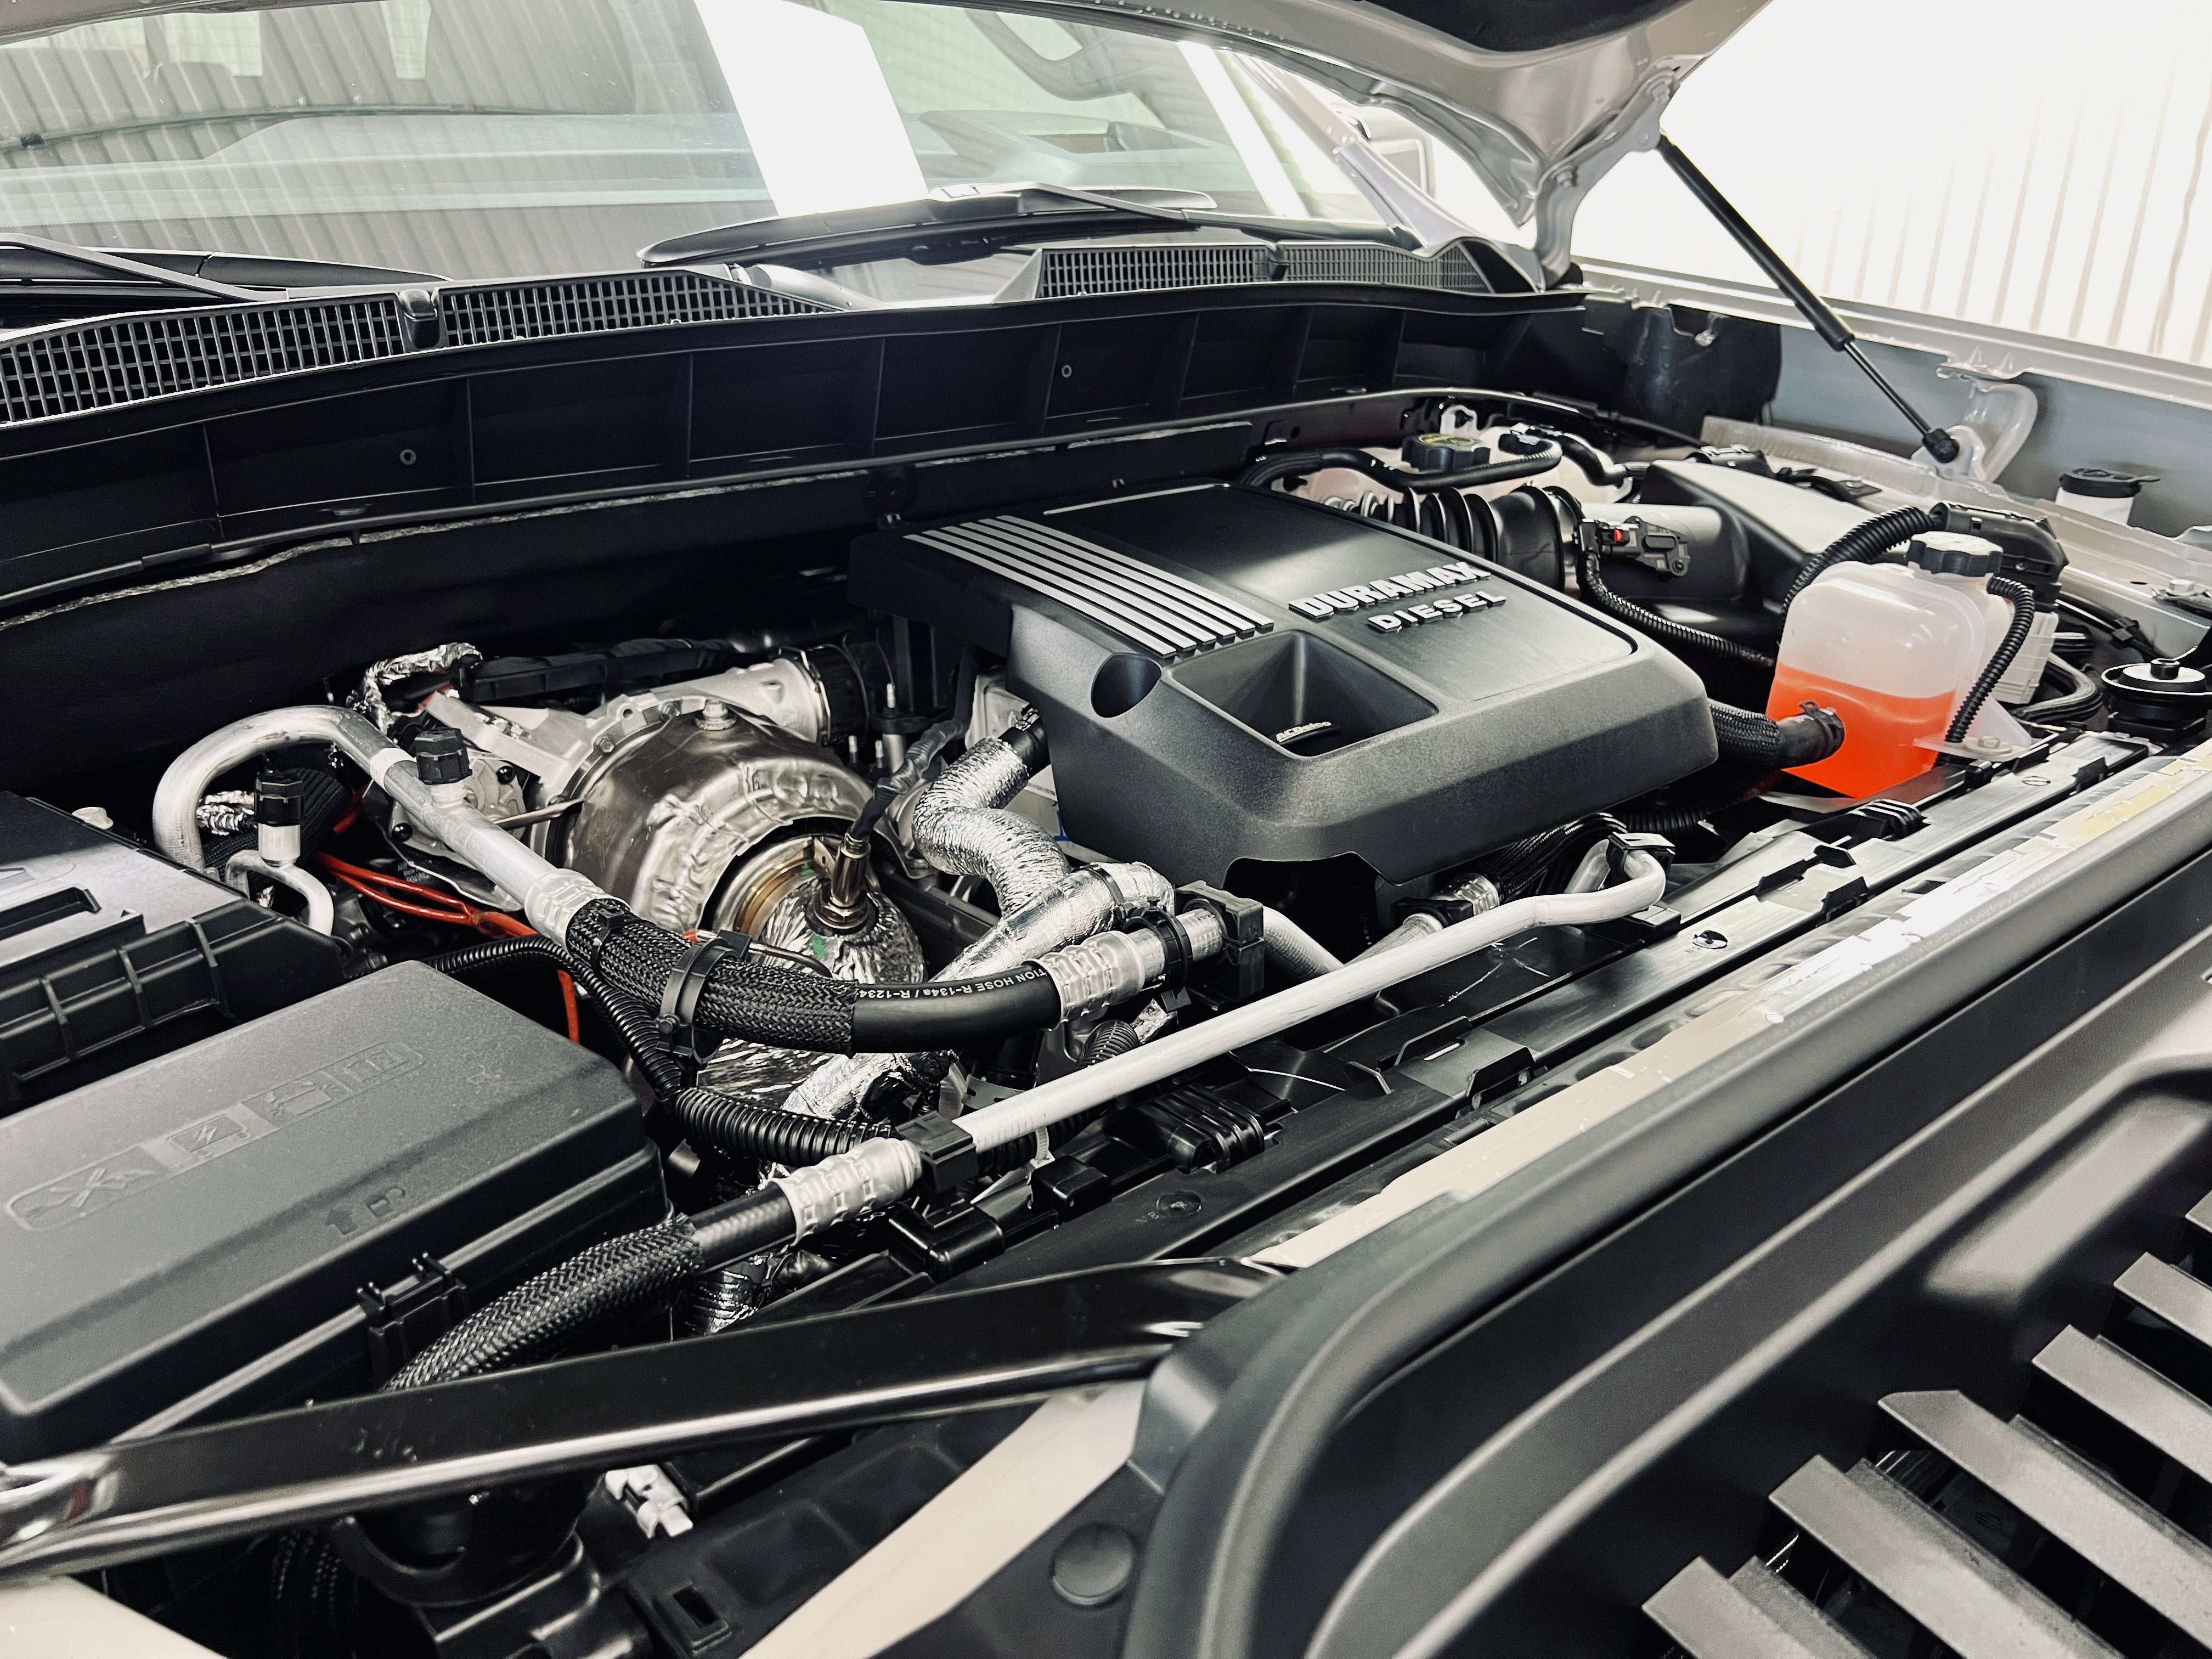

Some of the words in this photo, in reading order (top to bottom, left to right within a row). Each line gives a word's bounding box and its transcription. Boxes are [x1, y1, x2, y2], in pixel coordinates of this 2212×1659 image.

[1288, 561, 1492, 619] DURAMAX
[1368, 590, 1506, 631] DIESEL
[1276, 721, 1331, 742] ACDelco
[1015, 968, 1047, 983] TION
[923, 985, 973, 997] R-134a
[977, 977, 1014, 992] HOSE
[856, 989, 911, 999] R-1234
[914, 989, 919, 998] /
